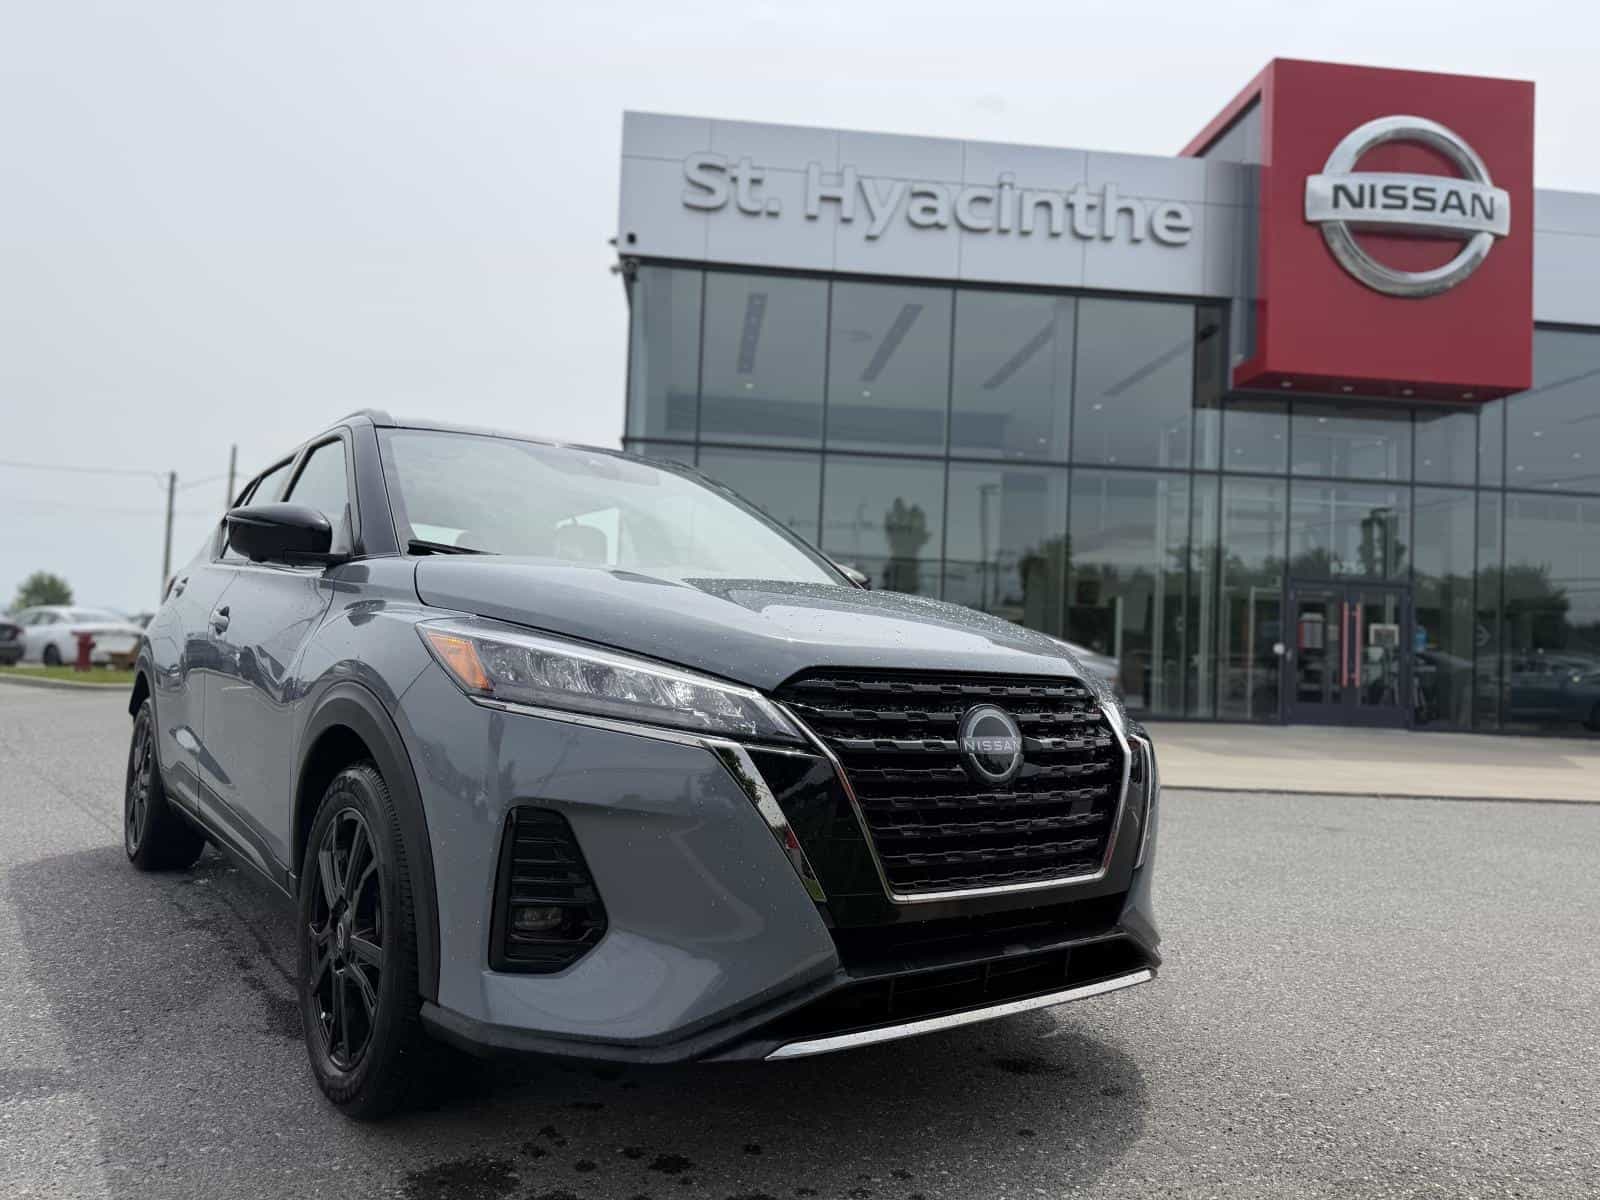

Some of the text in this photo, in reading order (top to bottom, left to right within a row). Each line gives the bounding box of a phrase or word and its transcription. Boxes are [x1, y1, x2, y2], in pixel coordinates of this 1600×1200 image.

[682, 152, 1194, 248] St. Hyacinthe
[1332, 184, 1494, 220] NISSAN
